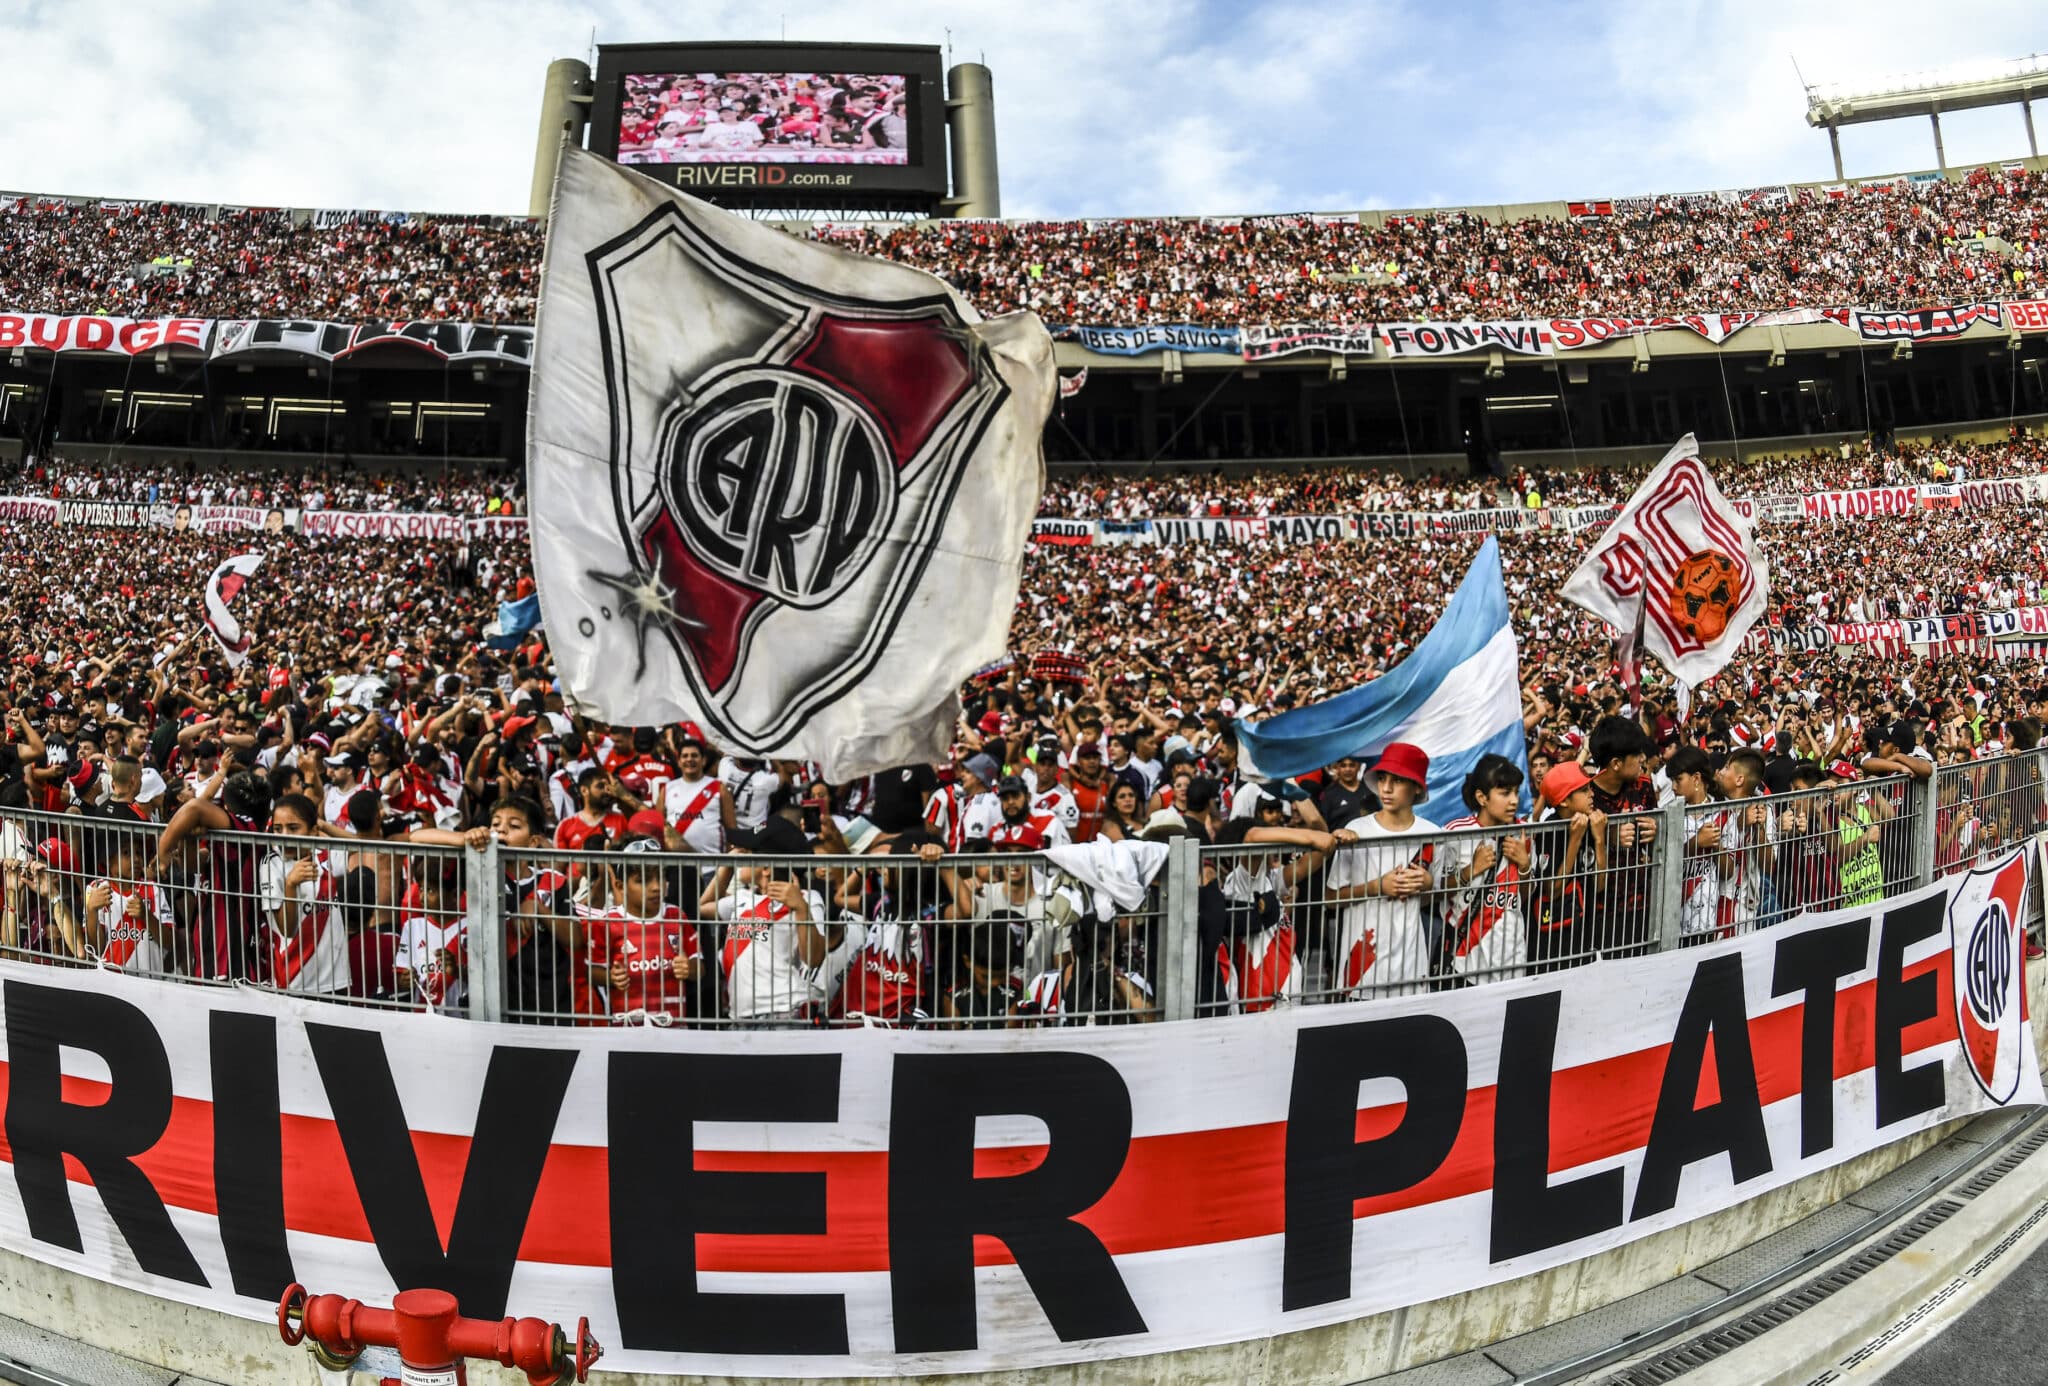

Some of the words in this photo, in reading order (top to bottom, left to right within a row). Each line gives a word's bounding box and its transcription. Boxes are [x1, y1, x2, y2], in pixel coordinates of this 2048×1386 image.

[0, 317, 205, 353] BUDGE
[1134, 328, 1158, 349] DE
[1164, 327, 1222, 348] SAVIO
[1277, 337, 1369, 351] ALIENTAN
[1388, 324, 1542, 357] FONAVI
[64, 502, 83, 525] LOS
[116, 504, 135, 526] DEL
[137, 506, 148, 528] 30
[1804, 487, 1918, 521] MATADEROS
[408, 516, 463, 539] RIVER
[1155, 521, 1230, 546] VILLA
[1269, 518, 1341, 544] MAYO
[1353, 513, 1415, 539] TESEI
[1910, 612, 2016, 643] PACHECO
[2019, 606, 2048, 633] GA
[5, 979, 1148, 1356] RIVER
[1283, 889, 1948, 1313] PLATE
